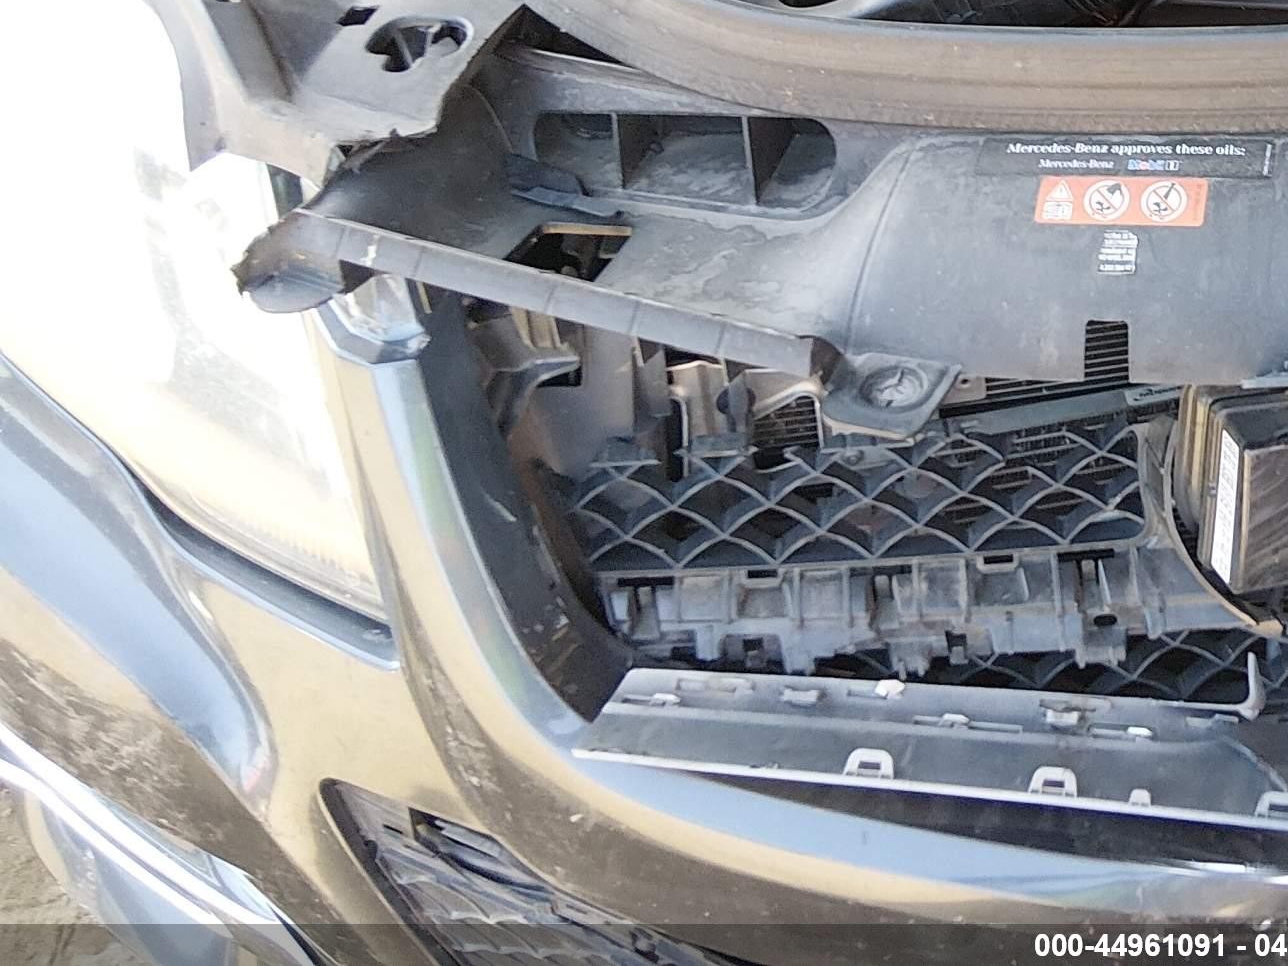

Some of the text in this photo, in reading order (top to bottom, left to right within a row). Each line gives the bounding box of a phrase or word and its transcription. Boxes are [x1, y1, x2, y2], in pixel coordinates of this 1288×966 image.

[1006, 143, 1246, 157] Mercedes-Benz approves these oils:
[1038, 158, 1115, 169] Mercedes-Benz
